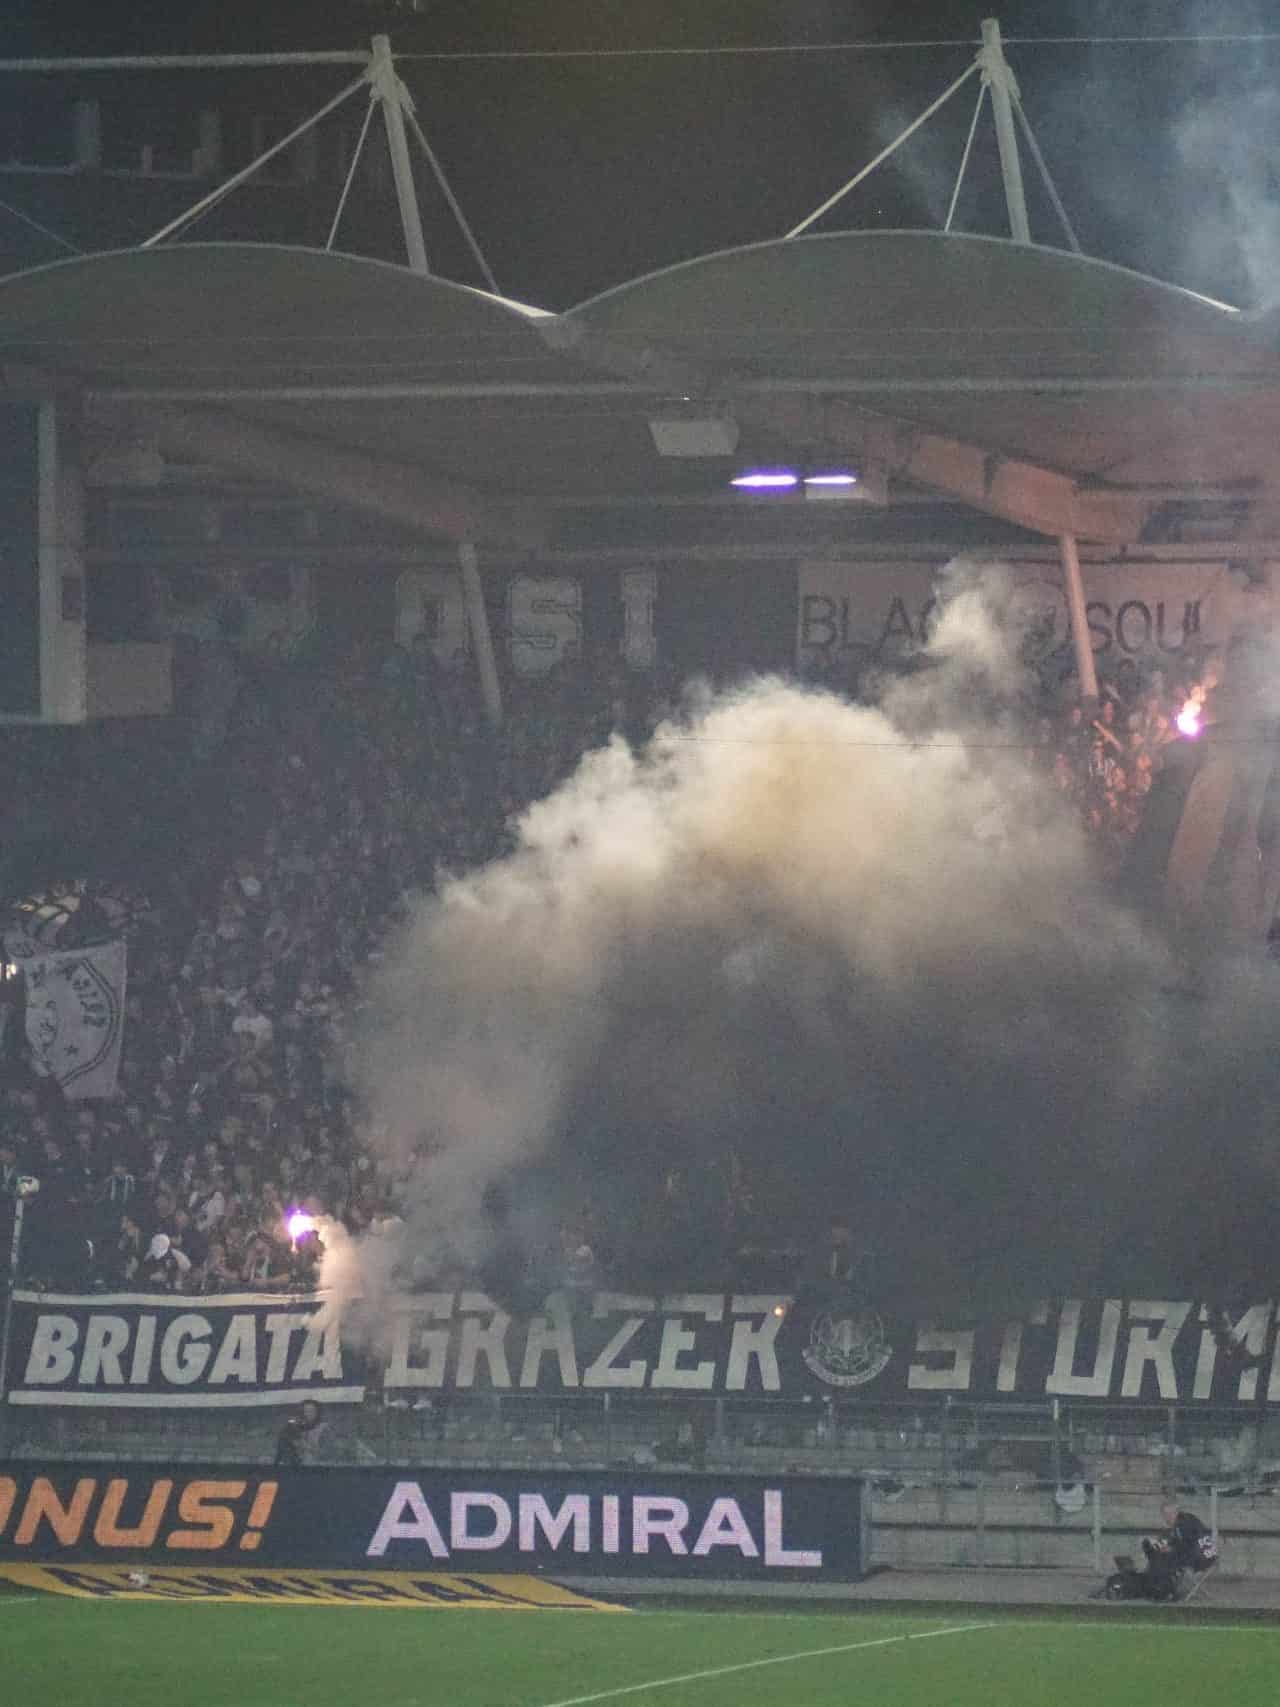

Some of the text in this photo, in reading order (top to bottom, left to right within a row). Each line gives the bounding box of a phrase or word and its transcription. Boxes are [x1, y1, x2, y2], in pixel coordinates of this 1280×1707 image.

[23, 1313, 344, 1385] BRIGATA
[383, 1292, 795, 1391] GRAZER
[366, 1481, 823, 1567] ADMIRAL
